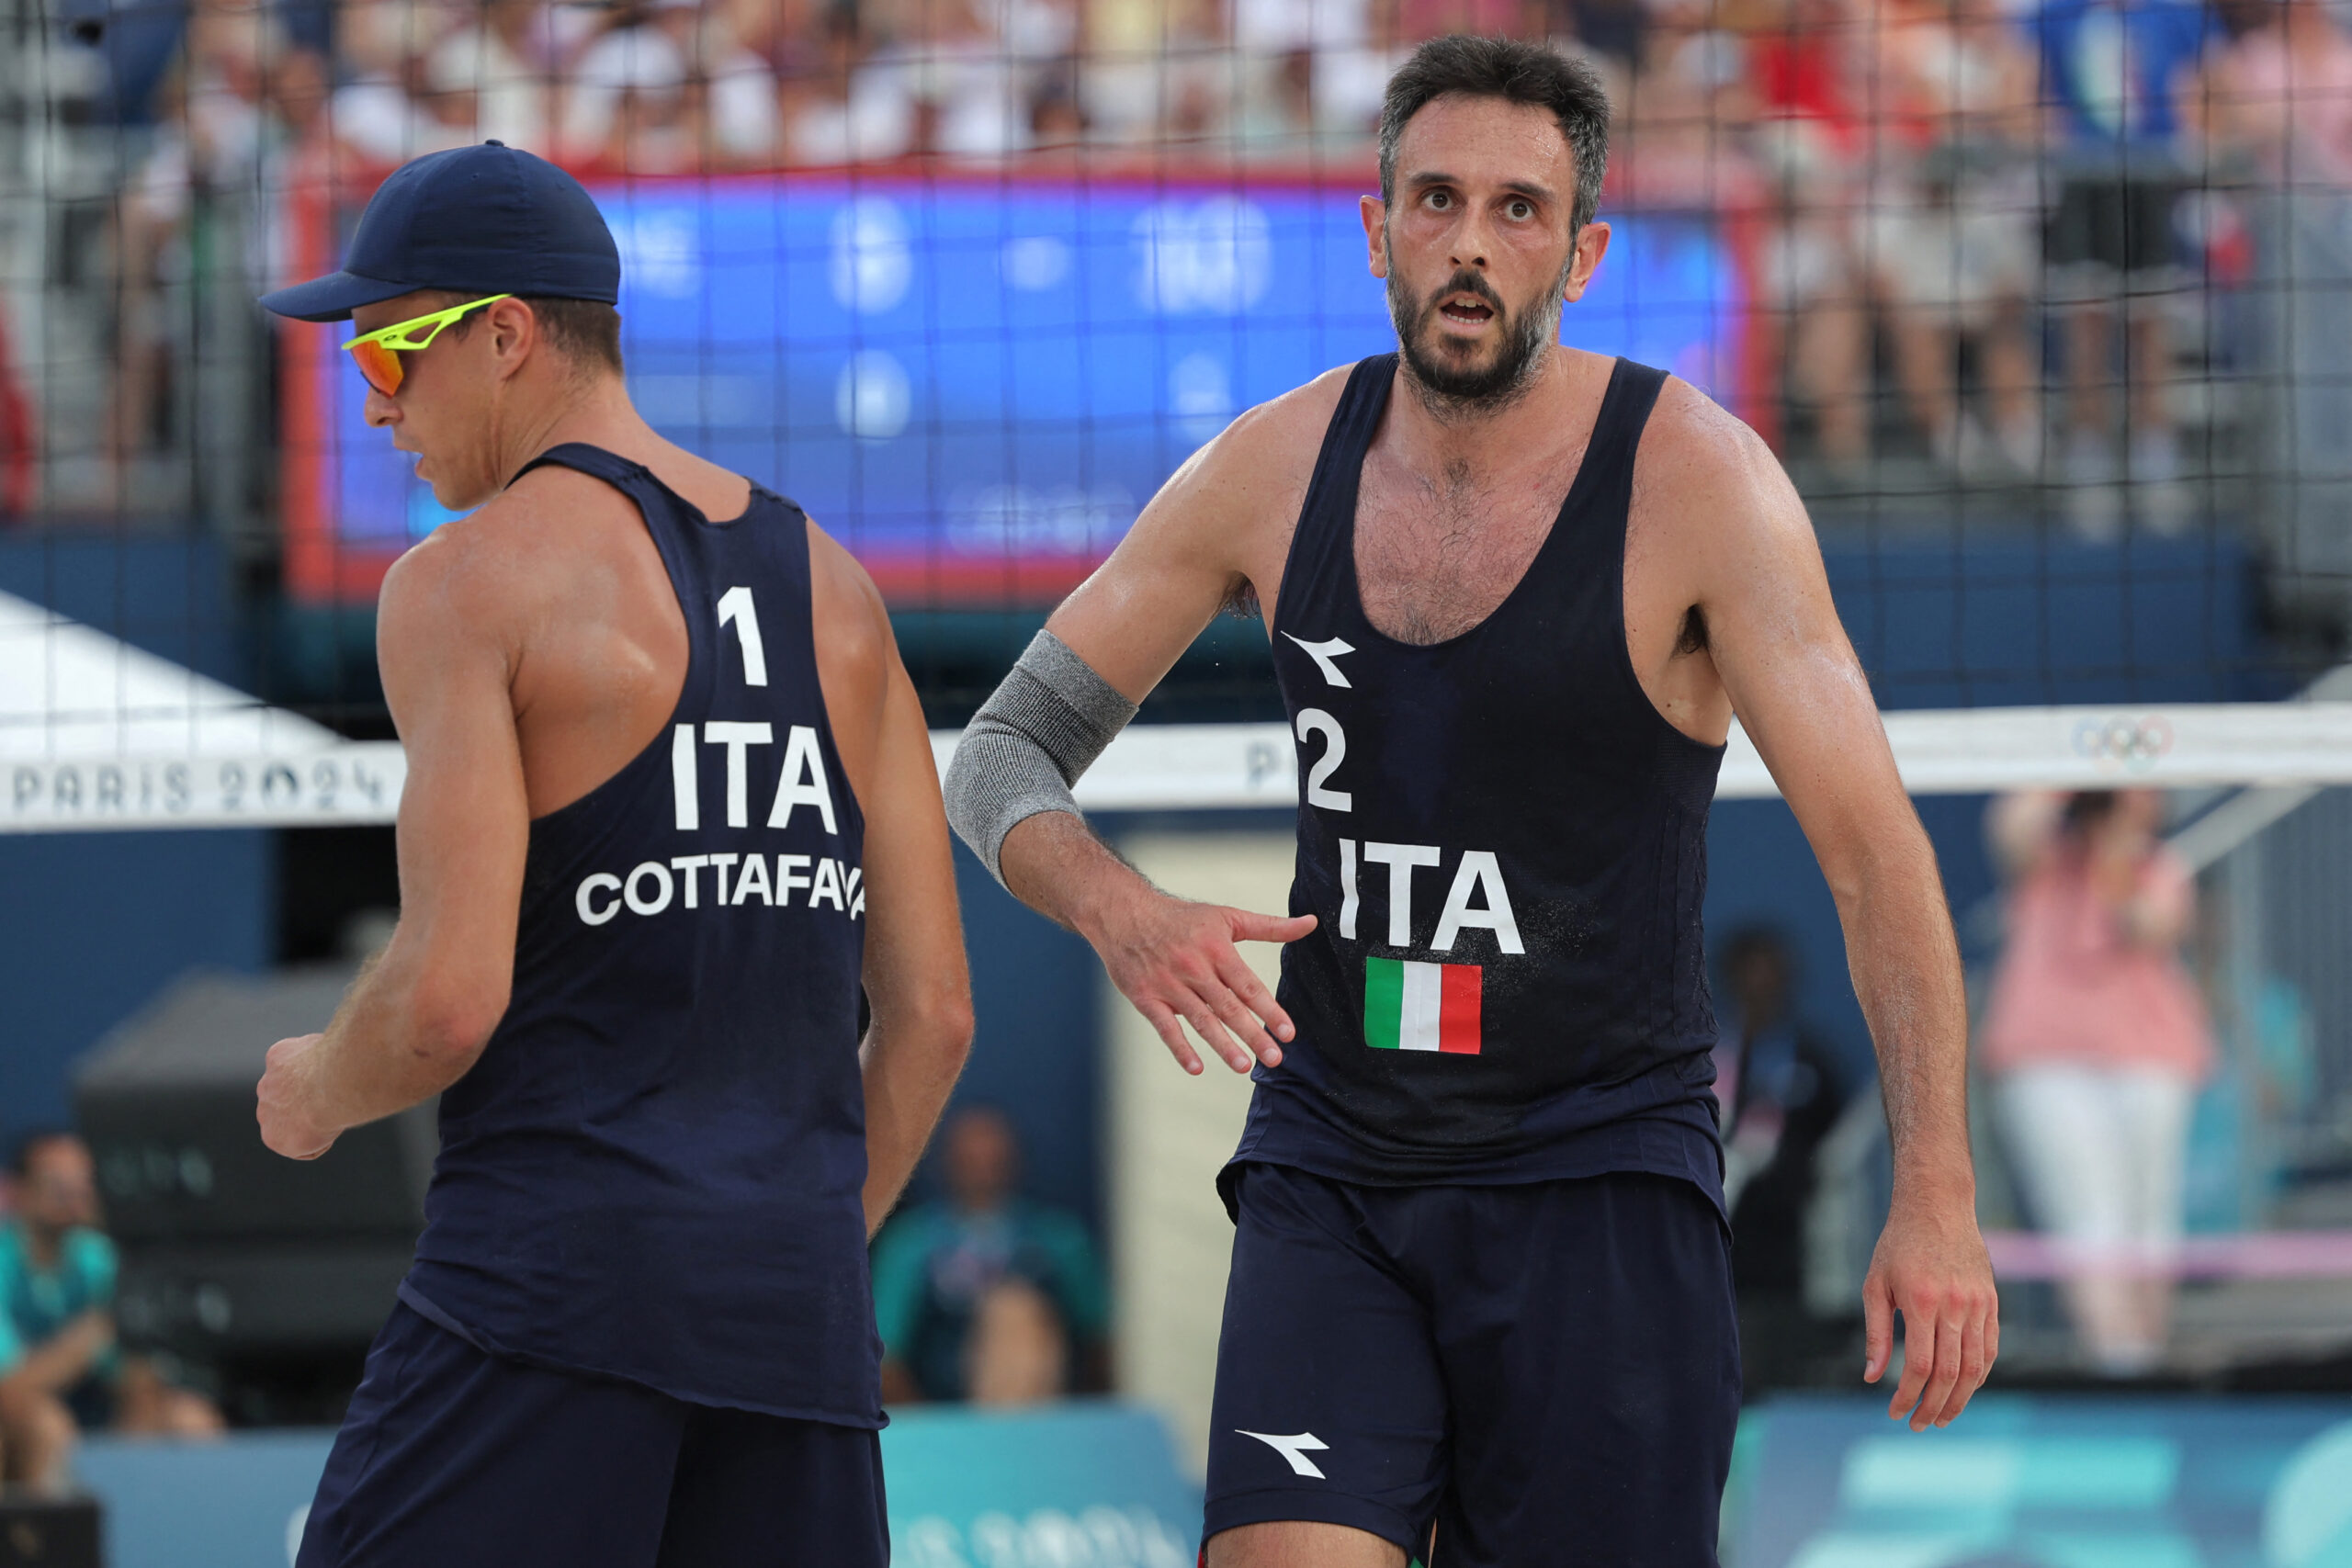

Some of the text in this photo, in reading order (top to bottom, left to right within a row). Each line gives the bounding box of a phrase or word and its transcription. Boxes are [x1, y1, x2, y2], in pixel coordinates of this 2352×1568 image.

[718, 586, 768, 686] 1
[672, 721, 838, 836] ITA
[1296, 707, 1352, 813] 2
[1339, 838, 1526, 955] ITA
